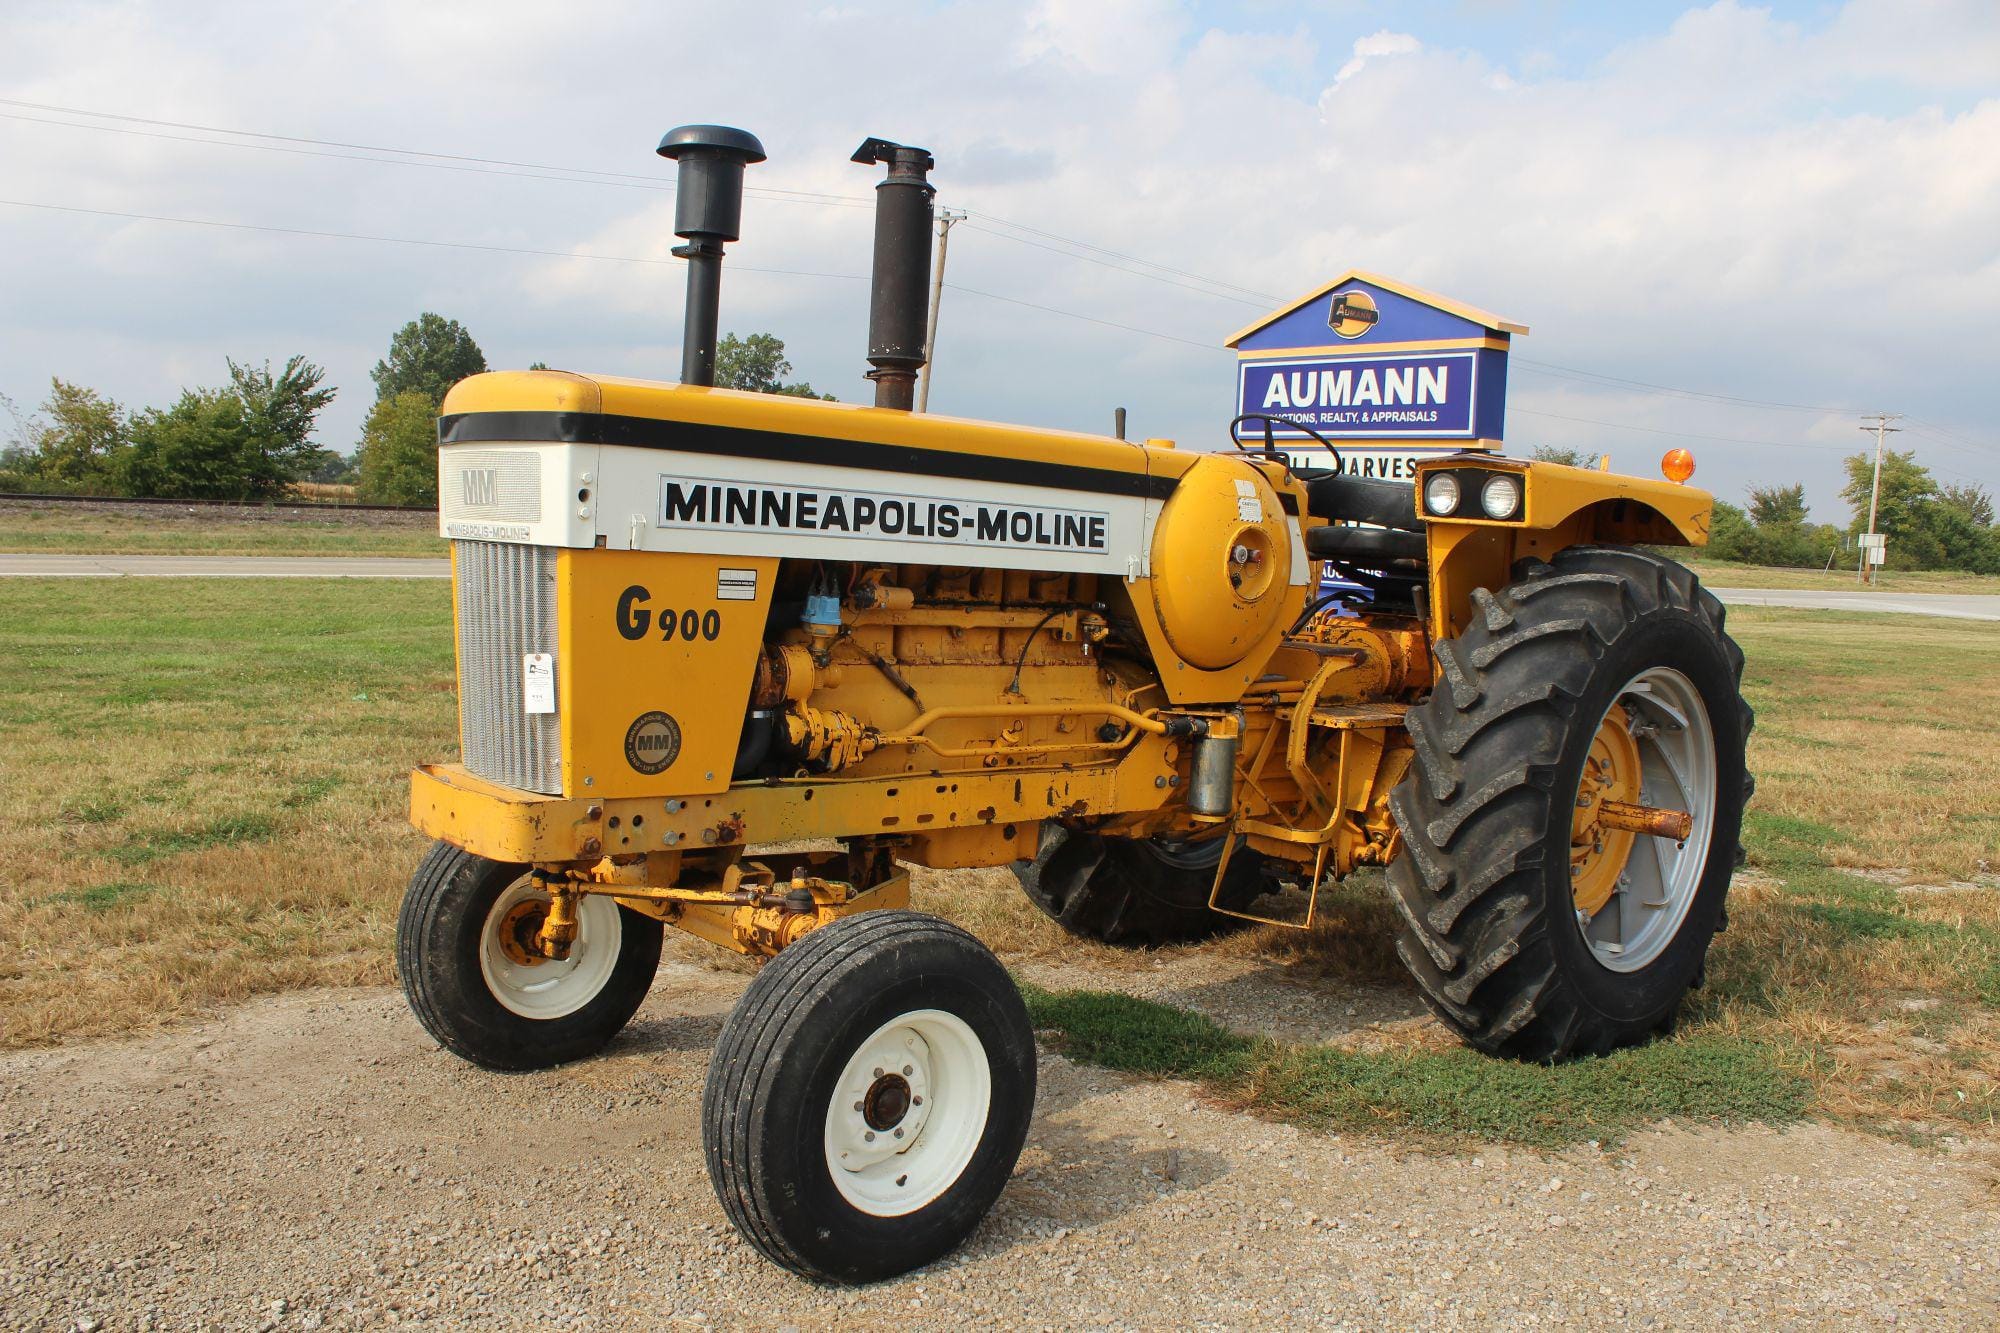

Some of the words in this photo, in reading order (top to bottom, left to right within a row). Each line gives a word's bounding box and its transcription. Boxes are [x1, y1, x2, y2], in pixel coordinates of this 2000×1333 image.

[1262, 365, 1448, 408] AUMANN
[1320, 412, 1359, 424] REALTY,
[1361, 411, 1369, 422] &
[1370, 411, 1438, 423] APPRAISALS
[462, 469, 497, 505] MM
[665, 482, 1104, 548] MINNEAPOLIS-MOLINE
[637, 734, 670, 751] MM
